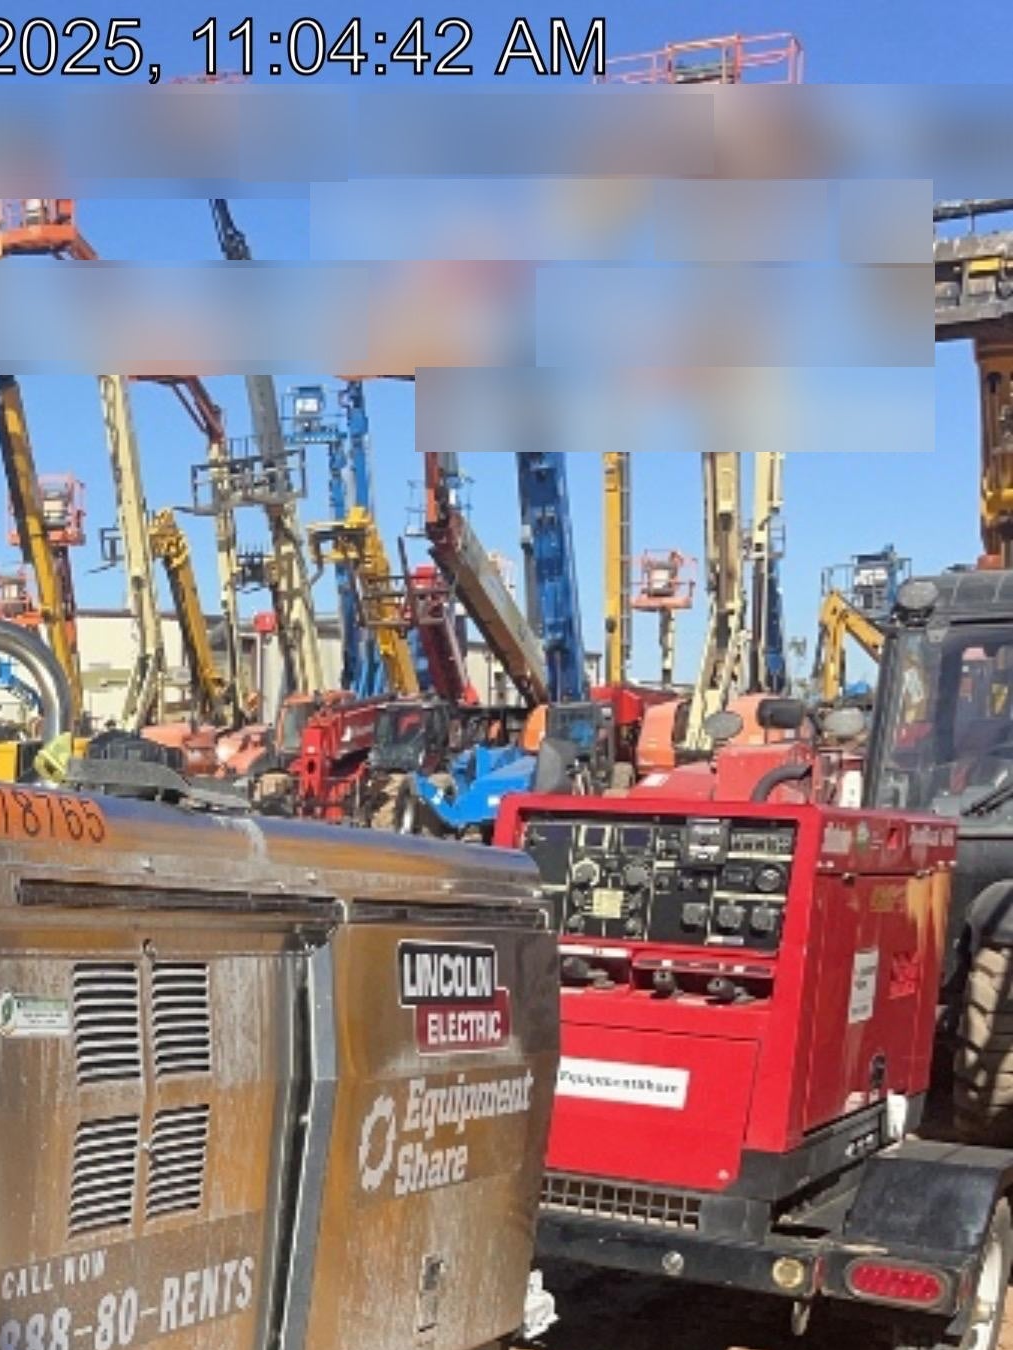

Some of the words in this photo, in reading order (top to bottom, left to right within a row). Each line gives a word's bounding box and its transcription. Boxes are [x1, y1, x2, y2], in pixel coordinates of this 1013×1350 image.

[403, 952, 493, 998] LINCOLN
[427, 1012, 502, 1045] ELECTRIC
[402, 1068, 534, 1140] Equipment
[395, 1142, 468, 1196] Share
[1, 1262, 54, 1300] CALL
[64, 1250, 108, 1286] NOW
